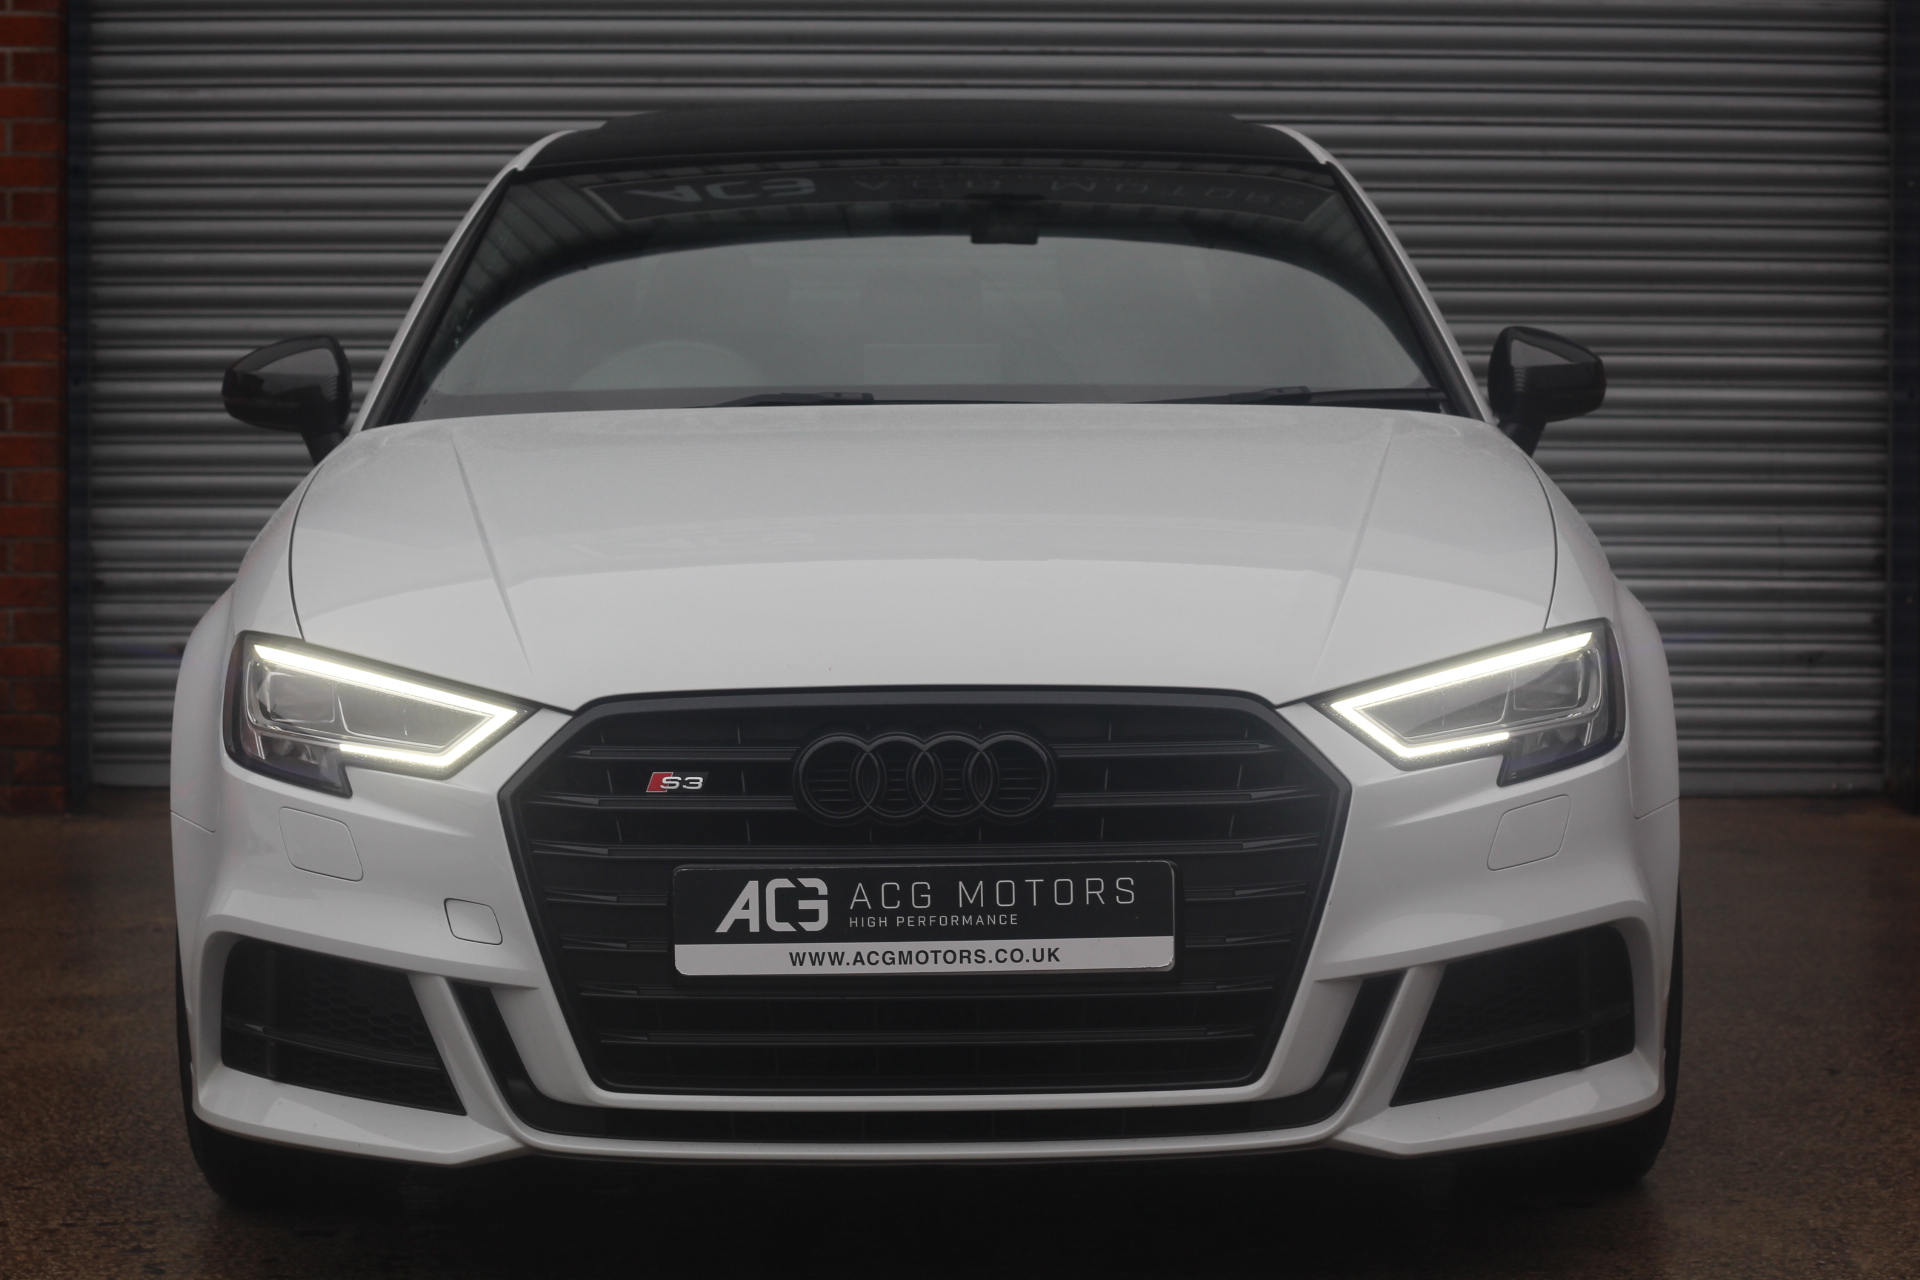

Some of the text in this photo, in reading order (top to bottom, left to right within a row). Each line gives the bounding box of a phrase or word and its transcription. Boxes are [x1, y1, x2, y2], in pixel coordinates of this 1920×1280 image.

[660, 776, 704, 790] S3
[849, 877, 1135, 910] ACG MOTORS
[715, 877, 829, 933] ACG
[849, 913, 1018, 928] HIGH PERFORMANCE
[788, 947, 1061, 967] WWW.ACGMOTORS.CO.UK
